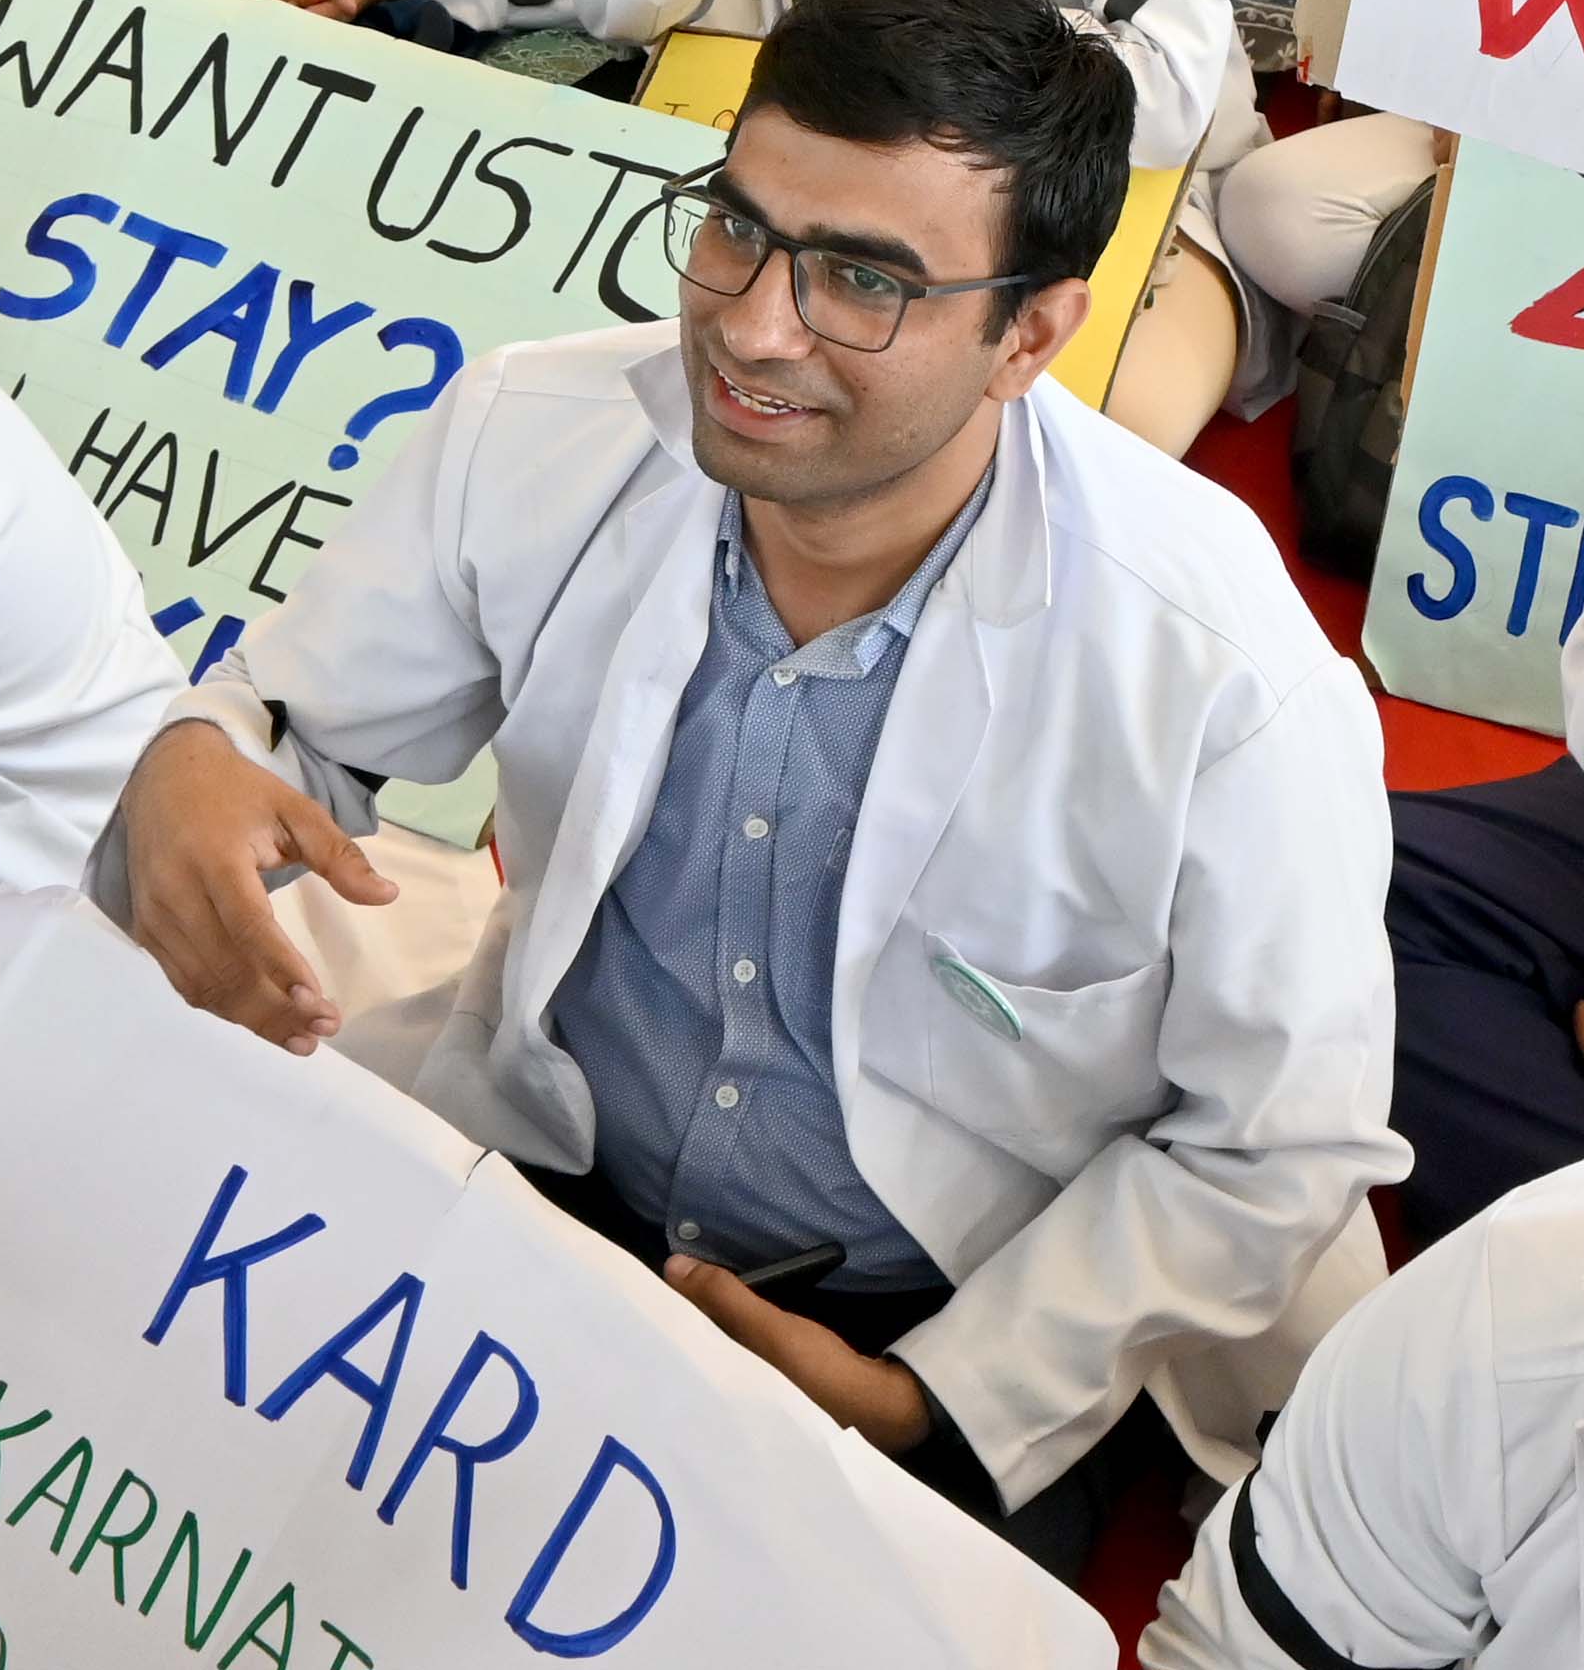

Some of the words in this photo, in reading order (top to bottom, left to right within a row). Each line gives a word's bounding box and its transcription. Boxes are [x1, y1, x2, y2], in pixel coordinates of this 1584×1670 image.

[366, 105, 574, 263] US
[68, 406, 353, 602] HAVE
[141, 1165, 675, 1660] KARD
